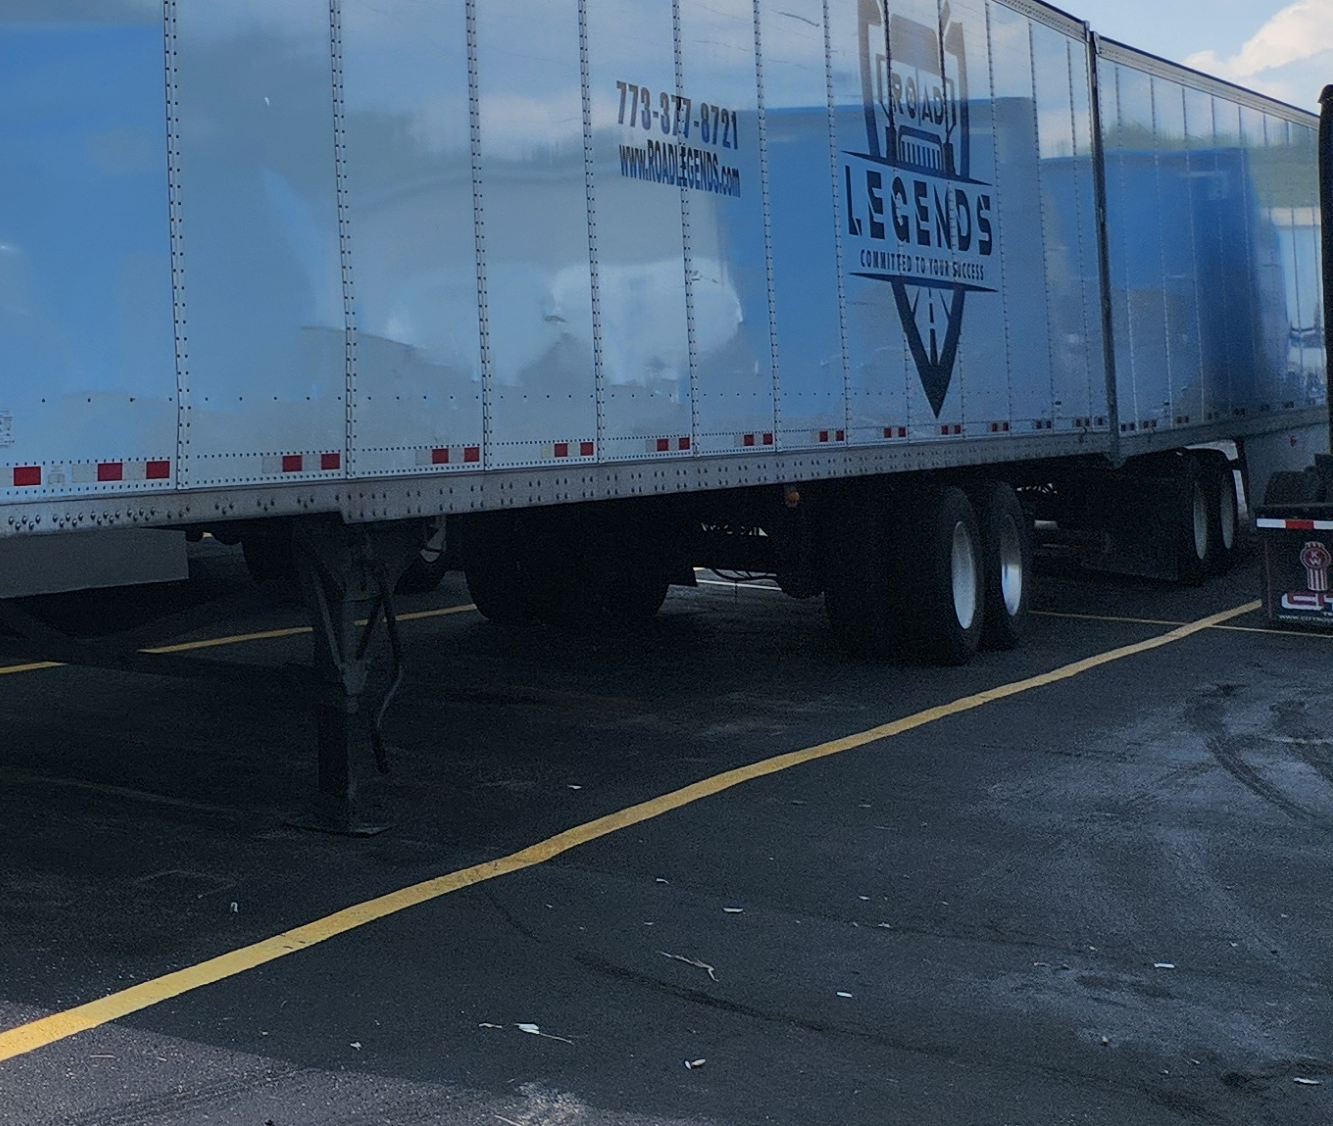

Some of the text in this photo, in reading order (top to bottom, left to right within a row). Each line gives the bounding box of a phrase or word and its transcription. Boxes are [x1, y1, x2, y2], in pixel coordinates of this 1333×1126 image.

[616, 80, 739, 150] 773-377-8721
[891, 73, 947, 125] ROAD
[844, 165, 993, 256] LEGENDS
[860, 248, 985, 280] COMMITTED TO YOUR SUCCESS
